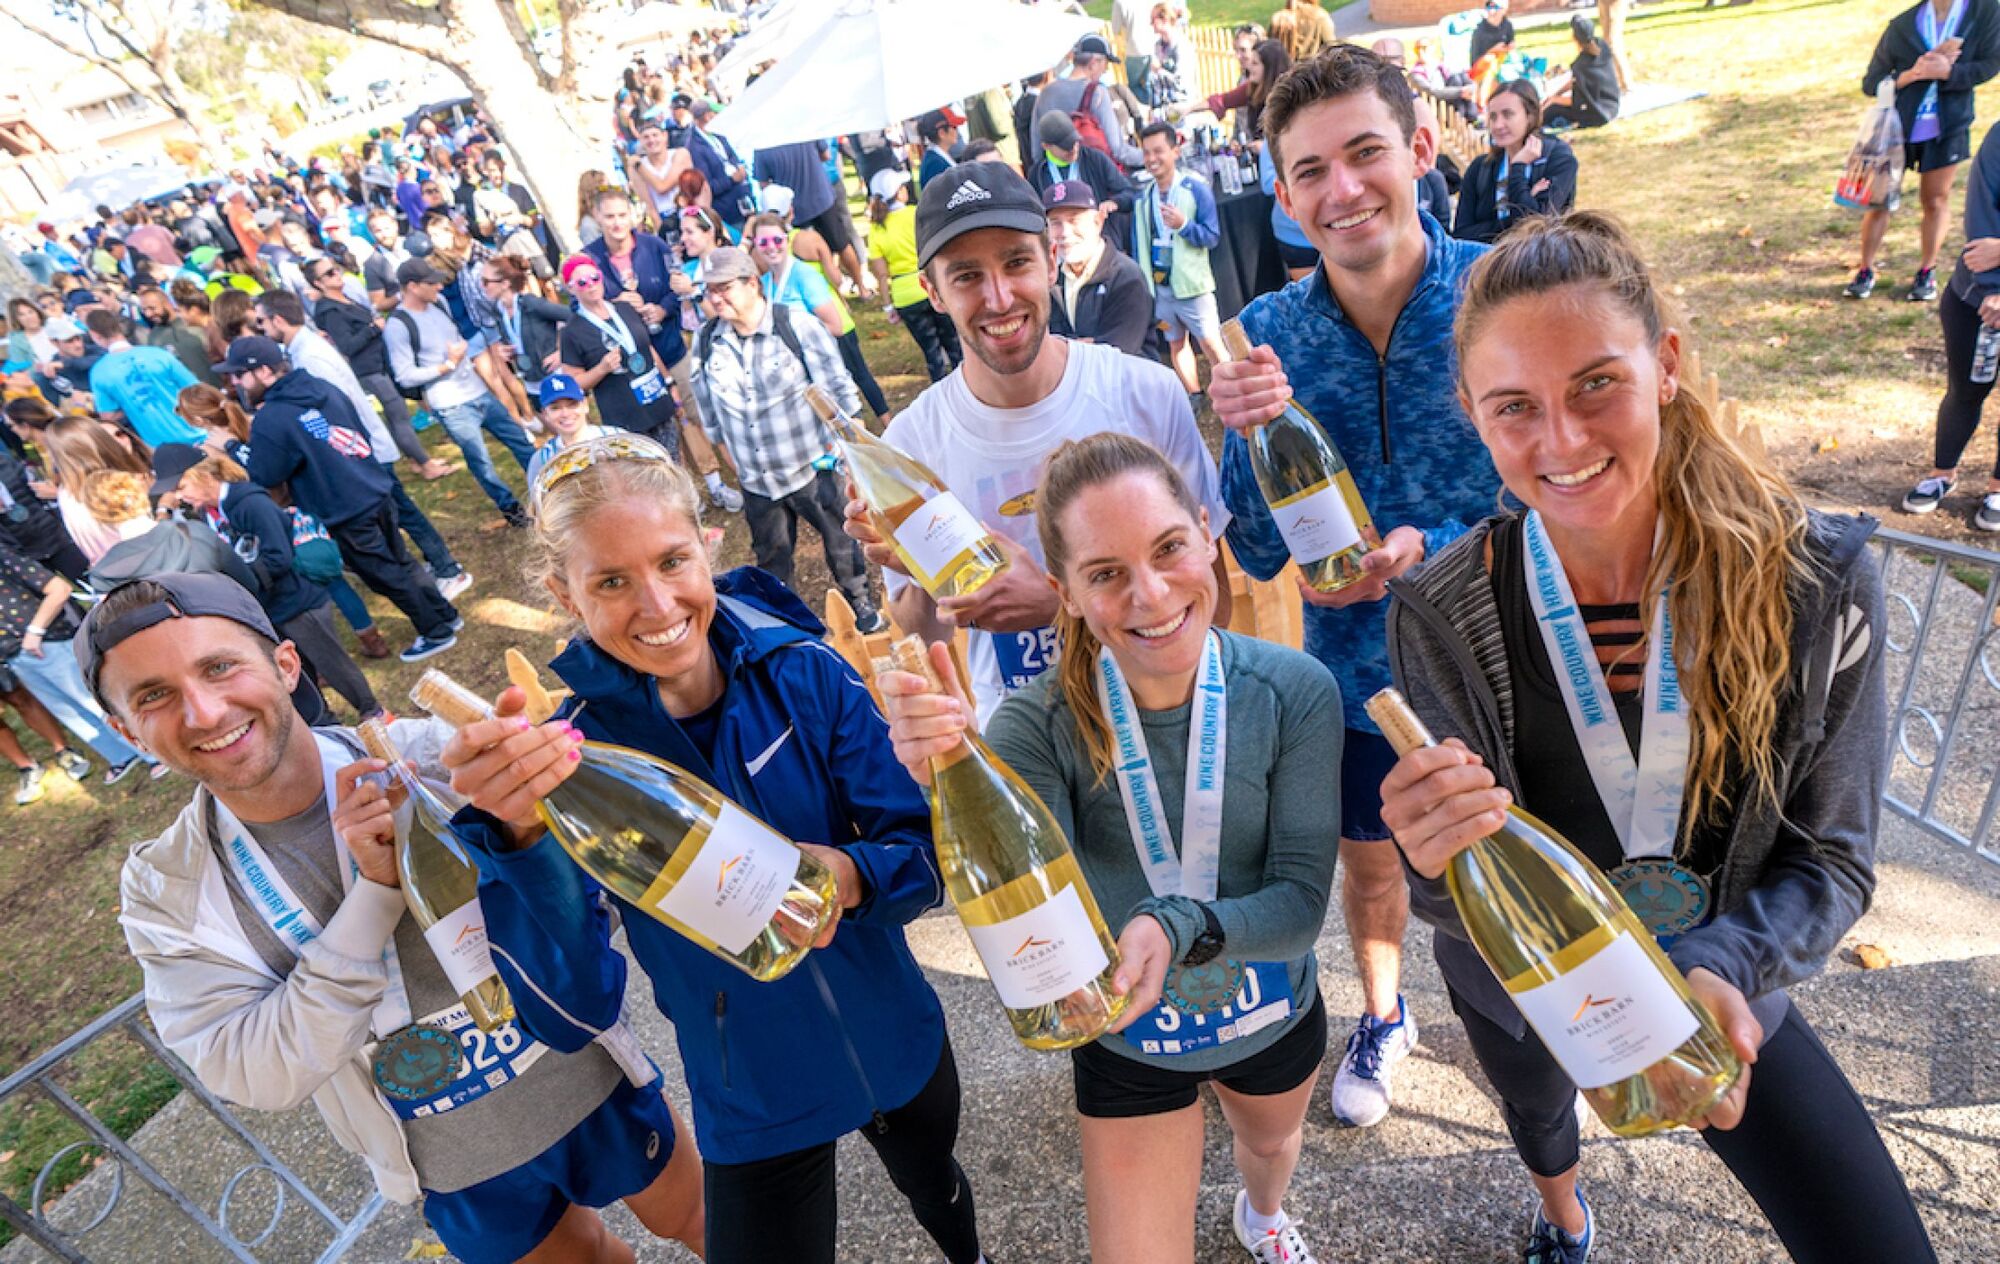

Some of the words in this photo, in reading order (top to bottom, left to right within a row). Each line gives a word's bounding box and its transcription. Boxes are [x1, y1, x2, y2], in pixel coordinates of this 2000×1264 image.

[946, 190, 992, 210] adidas
[1535, 573, 1561, 609] HALF
[1551, 623, 1590, 688] COUNTRY
[1100, 659, 1128, 725] MARATHON
[1576, 688, 1605, 727] WINE
[1658, 677, 1677, 711] WINE
[1118, 728, 1137, 758] HALF
[1200, 696, 1217, 754] COUNTRY
[1198, 758, 1215, 789] WINE
[1127, 772, 1156, 832] COUNTRY
[1144, 833, 1167, 864] WINE
[230, 835, 256, 866] WINE
[244, 863, 289, 915] COUNTRY
[714, 876, 739, 907] BRICK
[736, 847, 754, 875] BARN
[1006, 954, 1036, 967] BRICK
[1038, 939, 1064, 956] BARN
[1566, 1015, 1602, 1036] BRICK
[1602, 995, 1633, 1018] BARN
[457, 1021, 521, 1080] 28
